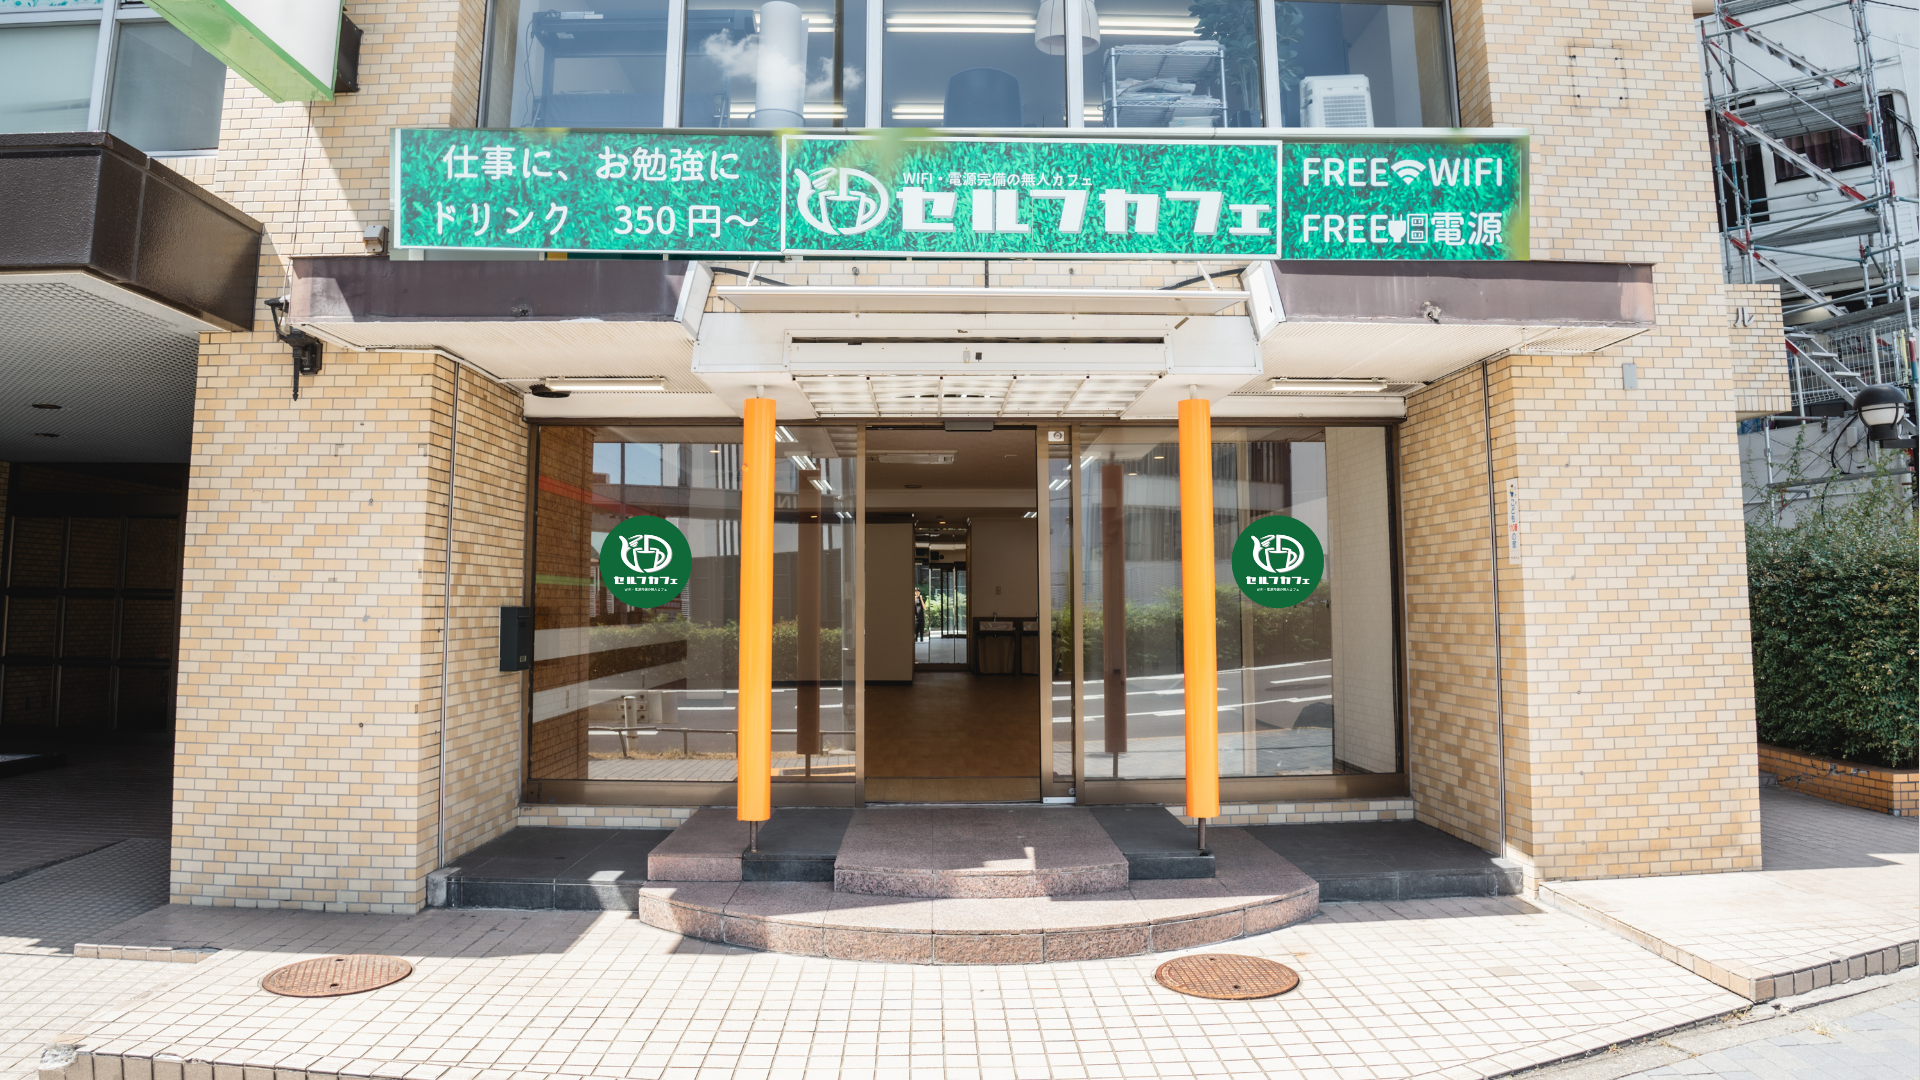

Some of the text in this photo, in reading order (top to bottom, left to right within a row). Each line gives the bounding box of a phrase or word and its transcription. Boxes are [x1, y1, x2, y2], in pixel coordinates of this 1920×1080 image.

[442, 144, 741, 183] 仕事に、 お勉強に
[1303, 157, 1503, 187] FREE WIFI
[902, 171, 1094, 187] WIFI・電源完備の無人カフェ
[436, 200, 569, 237] ドリンク
[896, 187, 1272, 236] セルフカフェ
[1303, 211, 1503, 247] FREE 電源
[1733, 306, 1756, 328] ル
[614, 575, 679, 585] セルフカフェ
[1245, 575, 1311, 585] セルフカフェ
